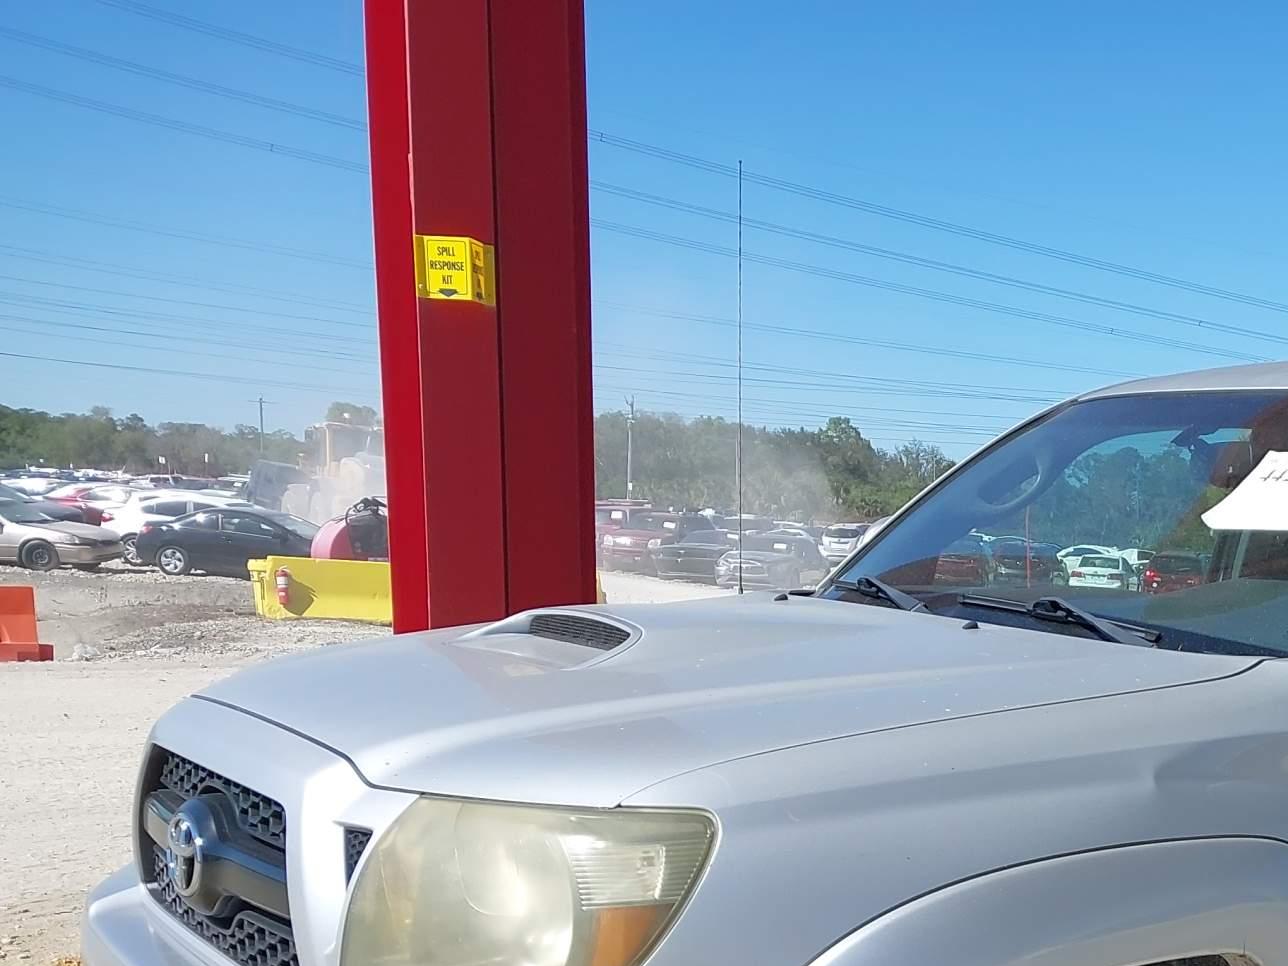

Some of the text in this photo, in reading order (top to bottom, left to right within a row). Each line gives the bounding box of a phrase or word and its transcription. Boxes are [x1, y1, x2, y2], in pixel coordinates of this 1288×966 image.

[436, 246, 456, 257] SPILL
[429, 261, 465, 272] RESPONSE
[441, 274, 453, 285] KIT
